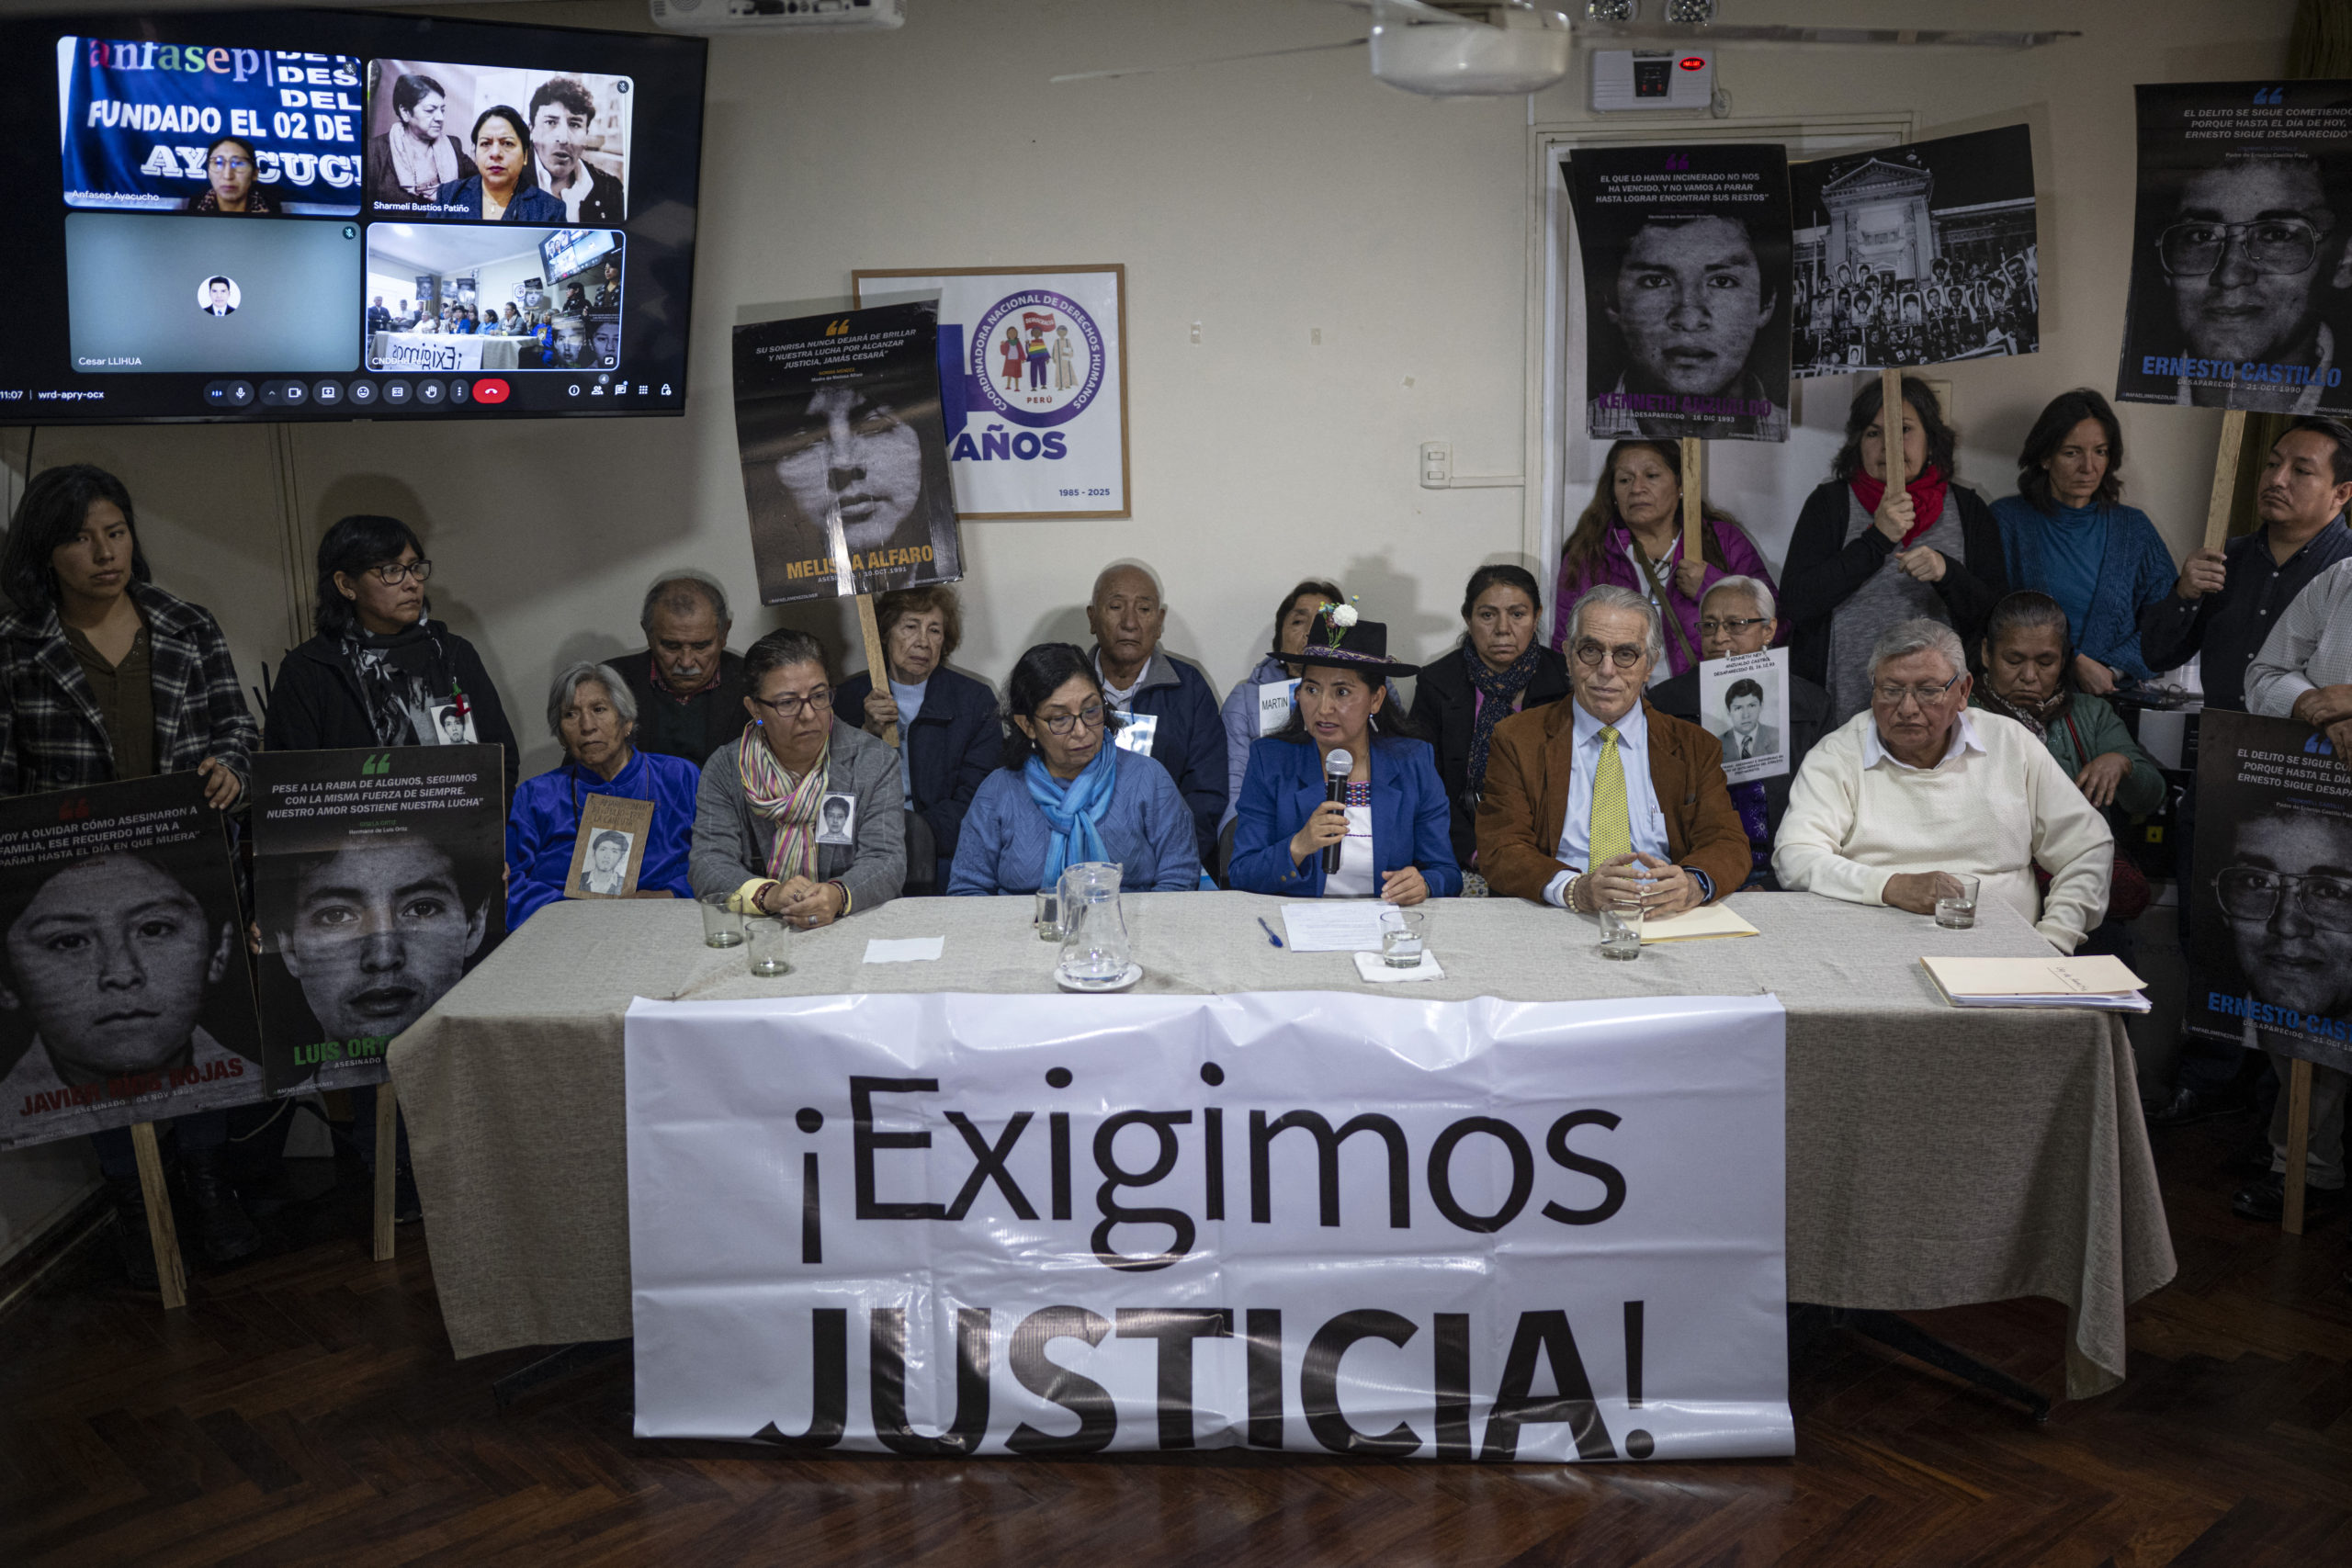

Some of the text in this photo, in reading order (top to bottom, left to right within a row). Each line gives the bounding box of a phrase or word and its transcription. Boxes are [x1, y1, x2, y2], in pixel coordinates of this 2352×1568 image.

[87, 101, 355, 141] FUNDADO EL 02 DE
[2251, 108, 2283, 117] SIGUE
[2191, 120, 2233, 129] PORQUE
[2235, 119, 2268, 128] HASTA
[2286, 118, 2304, 127] DÍA
[2324, 118, 2346, 128] HOY,
[2185, 130, 2232, 139] ERNESTO
[141, 145, 362, 189] AYCUC
[1612, 175, 1629, 183] QUE
[1673, 174, 1725, 182] INCINERADO
[1741, 173, 1760, 181] NOS
[73, 190, 160, 202] Anfasep Ayacucho
[1596, 195, 1623, 203] HASTA
[1659, 194, 1711, 202] ENCONTRAR
[1609, 185, 1621, 193] HA
[444, 204, 470, 212] Patiño
[755, 329, 917, 355] SU SONRISA NUNCA DEJARÁ DE BRILLAR
[775, 350, 813, 361] NUESTRA
[814, 347, 842, 356] LUCHA
[862, 339, 904, 351] ALCANZAR
[78, 357, 142, 366] Cesar LLIHUA
[784, 354, 851, 369] JUSTICIA, JAMÁS
[974, 294, 1102, 412] COORDINADORA NACIONAL DE DERECHOS HUMANOS
[2142, 355, 2342, 388] ERNESTO CASTILLO
[39, 390, 104, 400] wrd-apry-ocx
[2177, 378, 2237, 389] DESAPARECIDO
[2279, 386, 2301, 395] 1990
[1026, 395, 1053, 404] PERÚ
[1599, 392, 1772, 417] KENNETH ANZUALDO
[1634, 412, 1685, 420] DESAPARECIDO
[1703, 414, 1716, 423] DIC
[951, 423, 1068, 461] AÑOS
[1058, 489, 1110, 497] 1985 2025
[867, 545, 933, 570] ALFARO
[1261, 697, 1288, 711] MARTIN
[2237, 749, 2333, 769] EL DELITO SE SIGUE
[2237, 773, 2313, 792] ERNESTO SIGUE
[2244, 761, 2352, 784] PORQUE HASTA EL DÍA
[272, 773, 478, 794] PESE A LA RABIA DE ALGUNOS, SEGUIMOS
[285, 786, 466, 806] CON LA MISMA FUERZA DE SIEMPRE.
[266, 800, 446, 819] NUESTRO AMOR SOSTIENE NUESTRA
[21, 806, 198, 840] A OLVIDAR CÓMO ASESINARON A
[49, 821, 180, 850] ESE RECUERDO ME VA A
[38, 837, 154, 863] HASTA EL DÍA EN QUE
[2208, 991, 2299, 1029] ERNESTO
[2243, 1020, 2303, 1040] DESAPARECIDO
[294, 1041, 340, 1066] LUIS
[334, 1057, 381, 1069] ASESINADO
[19, 1082, 102, 1117] JAVIER
[168, 1057, 244, 1089] ROJAS
[74, 1100, 126, 1116] ASESINADO
[151, 1089, 169, 1101] NOV
[794, 1061, 1627, 1273] ¡Exigimos
[749, 1300, 1657, 1461] JUSTICIA!
